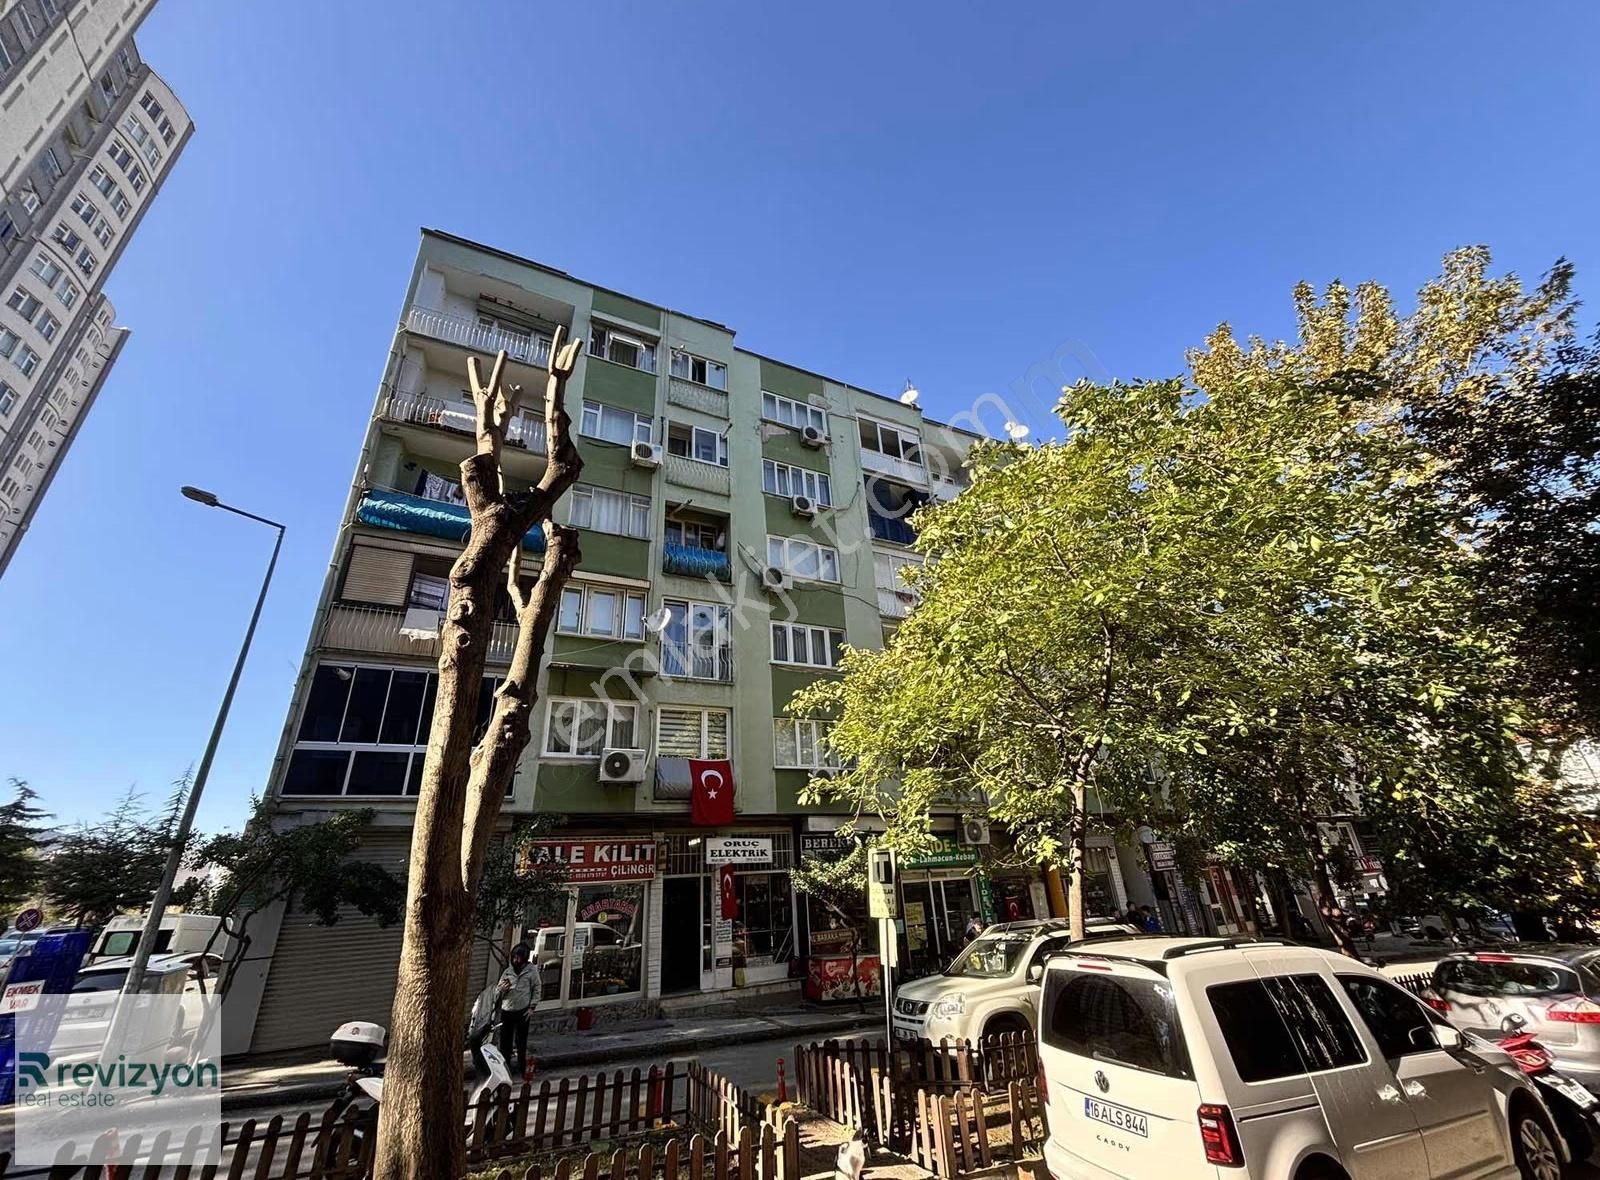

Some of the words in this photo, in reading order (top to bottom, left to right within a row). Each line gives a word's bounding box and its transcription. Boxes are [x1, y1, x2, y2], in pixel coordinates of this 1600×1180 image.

[723, 840, 760, 849] ORUÇ
[5, 983, 42, 998] EKMEK
[1090, 1101, 1100, 1118] 16
[1101, 1105, 1123, 1126] ALS
[1125, 1113, 1146, 1135] 844
[1096, 1134, 1131, 1152] CADDY
